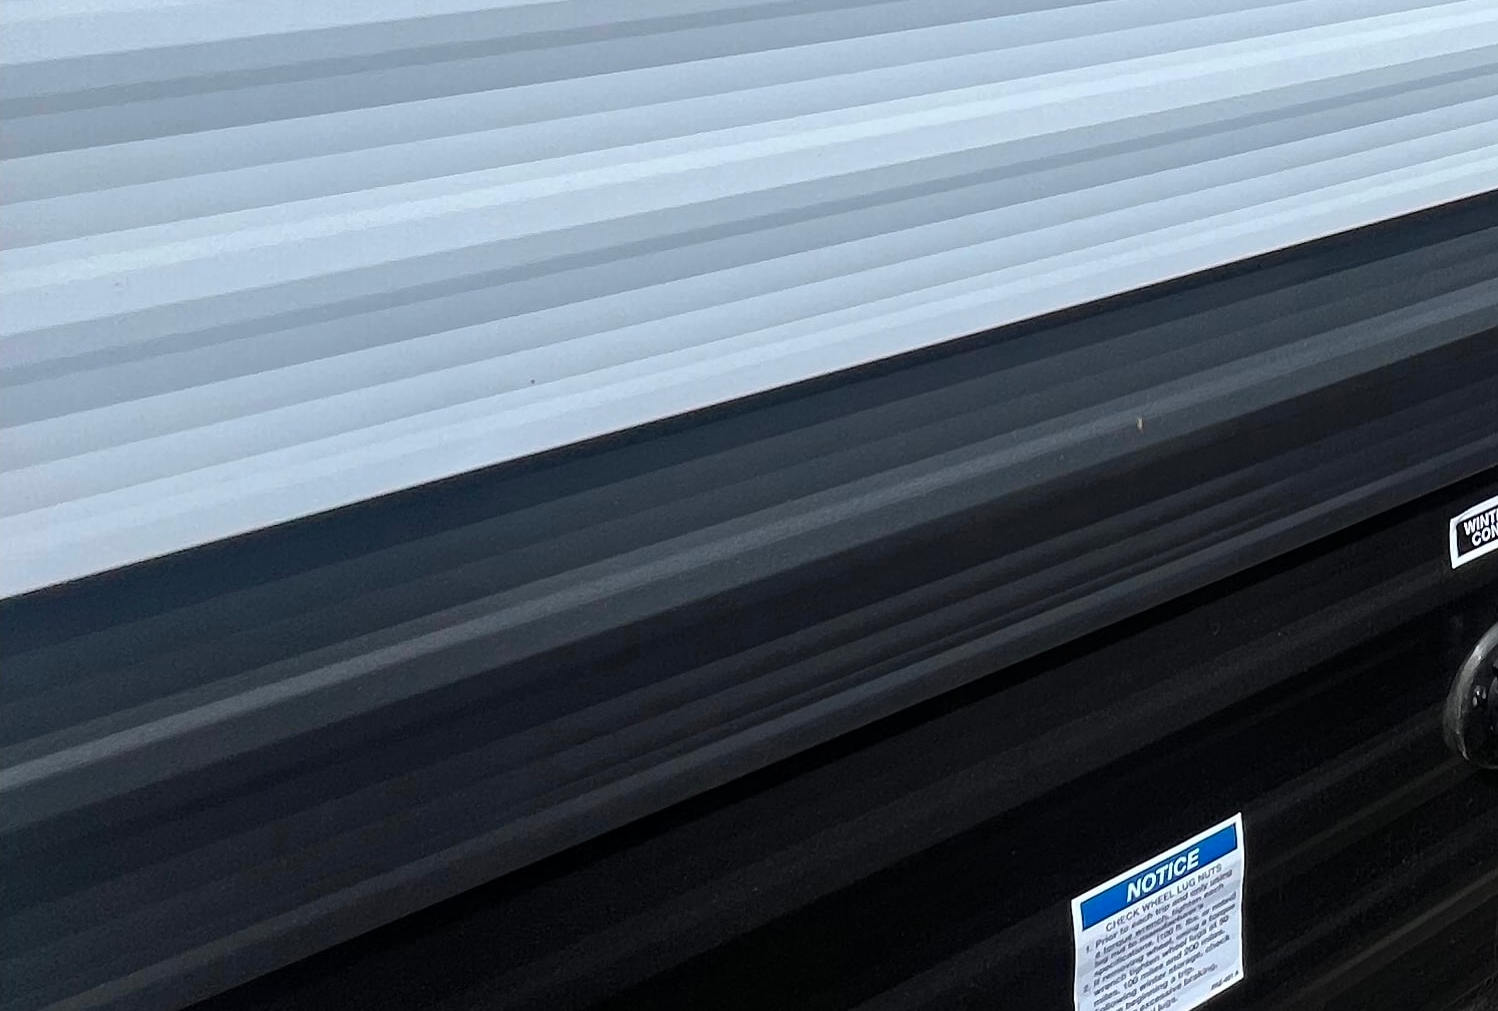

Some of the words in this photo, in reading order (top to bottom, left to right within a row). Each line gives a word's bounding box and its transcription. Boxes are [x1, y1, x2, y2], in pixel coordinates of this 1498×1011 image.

[1105, 907, 1139, 931] CHECK
[1142, 890, 1174, 912] WHEEL
[1177, 878, 1195, 894] LUG
[1198, 863, 1221, 882] NUTS
[1127, 848, 1199, 902] NOTICE
[1123, 976, 1138, 989] 100
[1184, 941, 1198, 955] 200
